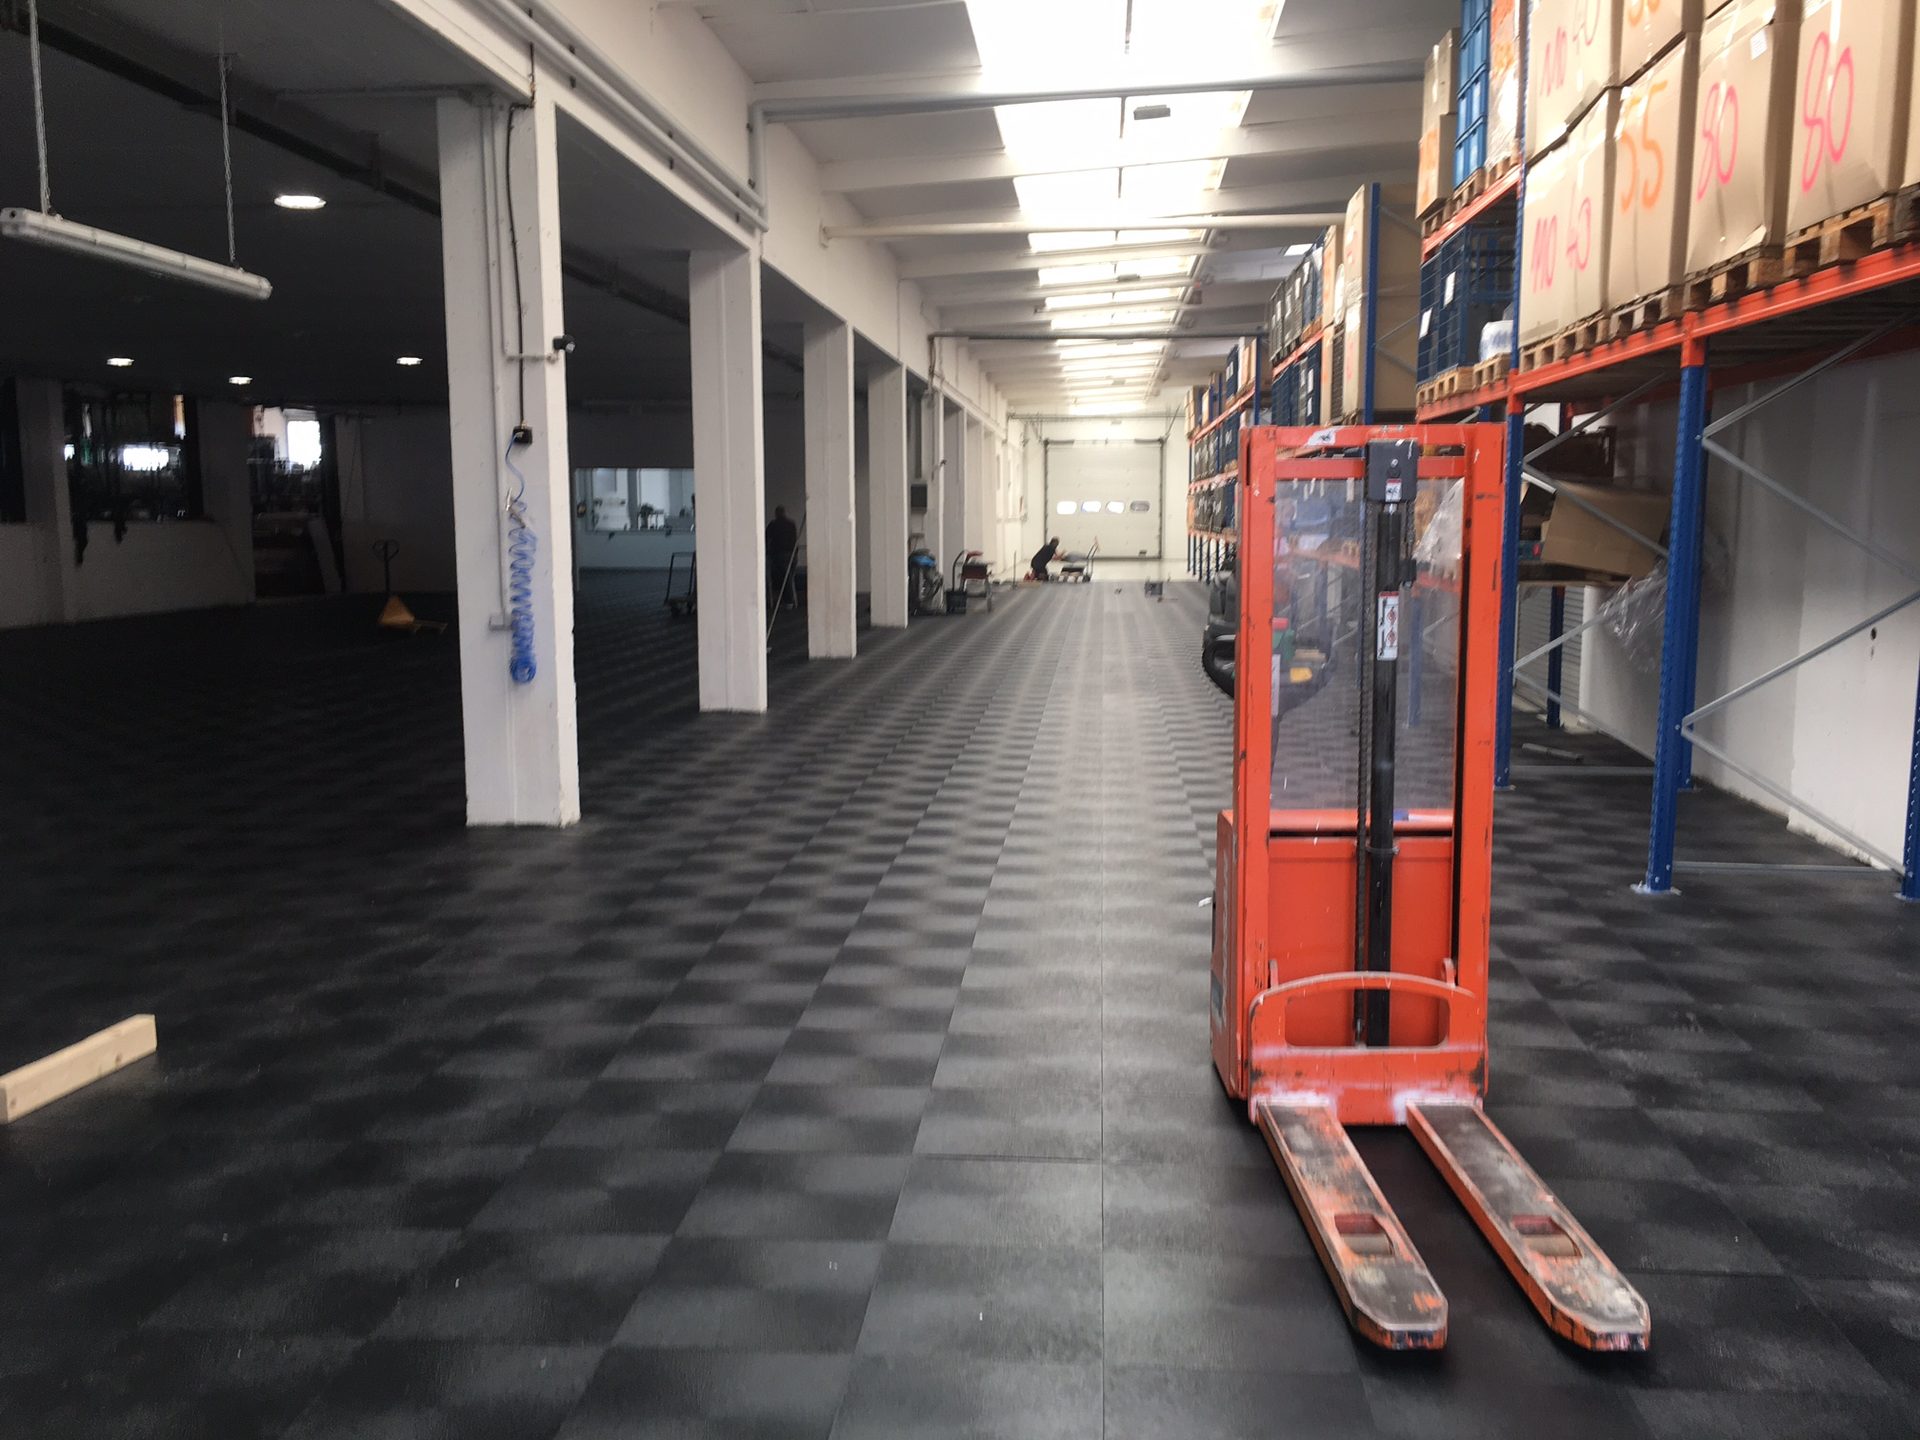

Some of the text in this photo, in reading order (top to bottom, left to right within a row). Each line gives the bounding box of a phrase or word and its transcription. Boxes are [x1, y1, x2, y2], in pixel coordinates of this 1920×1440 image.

[1620, 80, 1668, 214] 55
[1696, 82, 1739, 201] 80
[1801, 31, 1854, 193] 80
